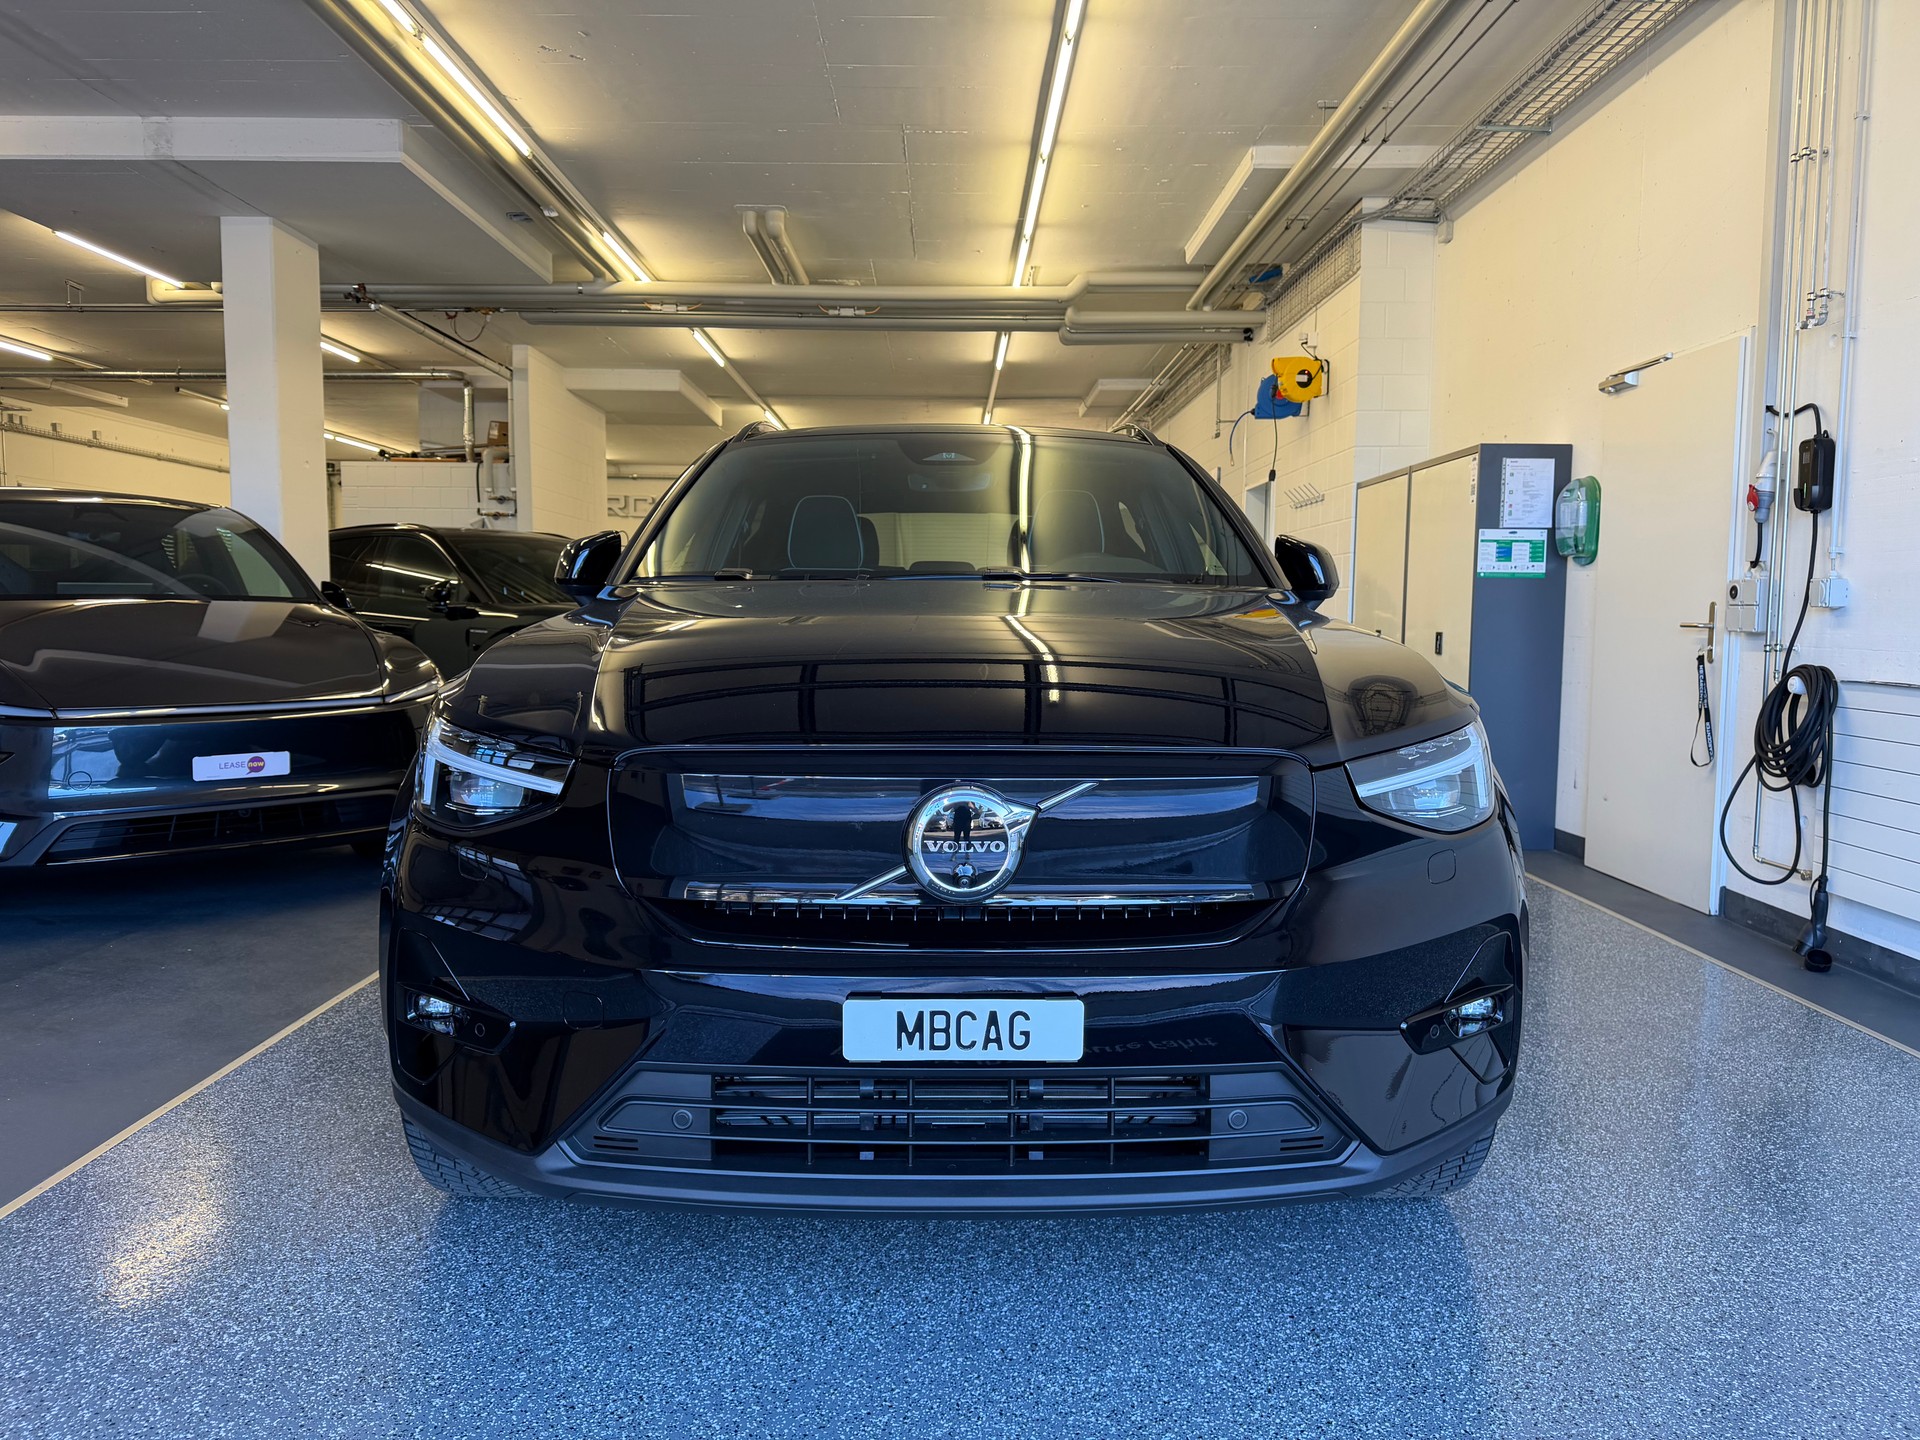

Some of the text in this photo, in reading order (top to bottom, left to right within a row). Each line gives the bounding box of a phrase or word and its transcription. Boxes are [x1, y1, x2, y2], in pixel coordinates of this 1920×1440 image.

[219, 760, 265, 770] LEASE now
[924, 840, 1006, 853] VOLVO
[896, 1010, 1031, 1051] MBCAG
